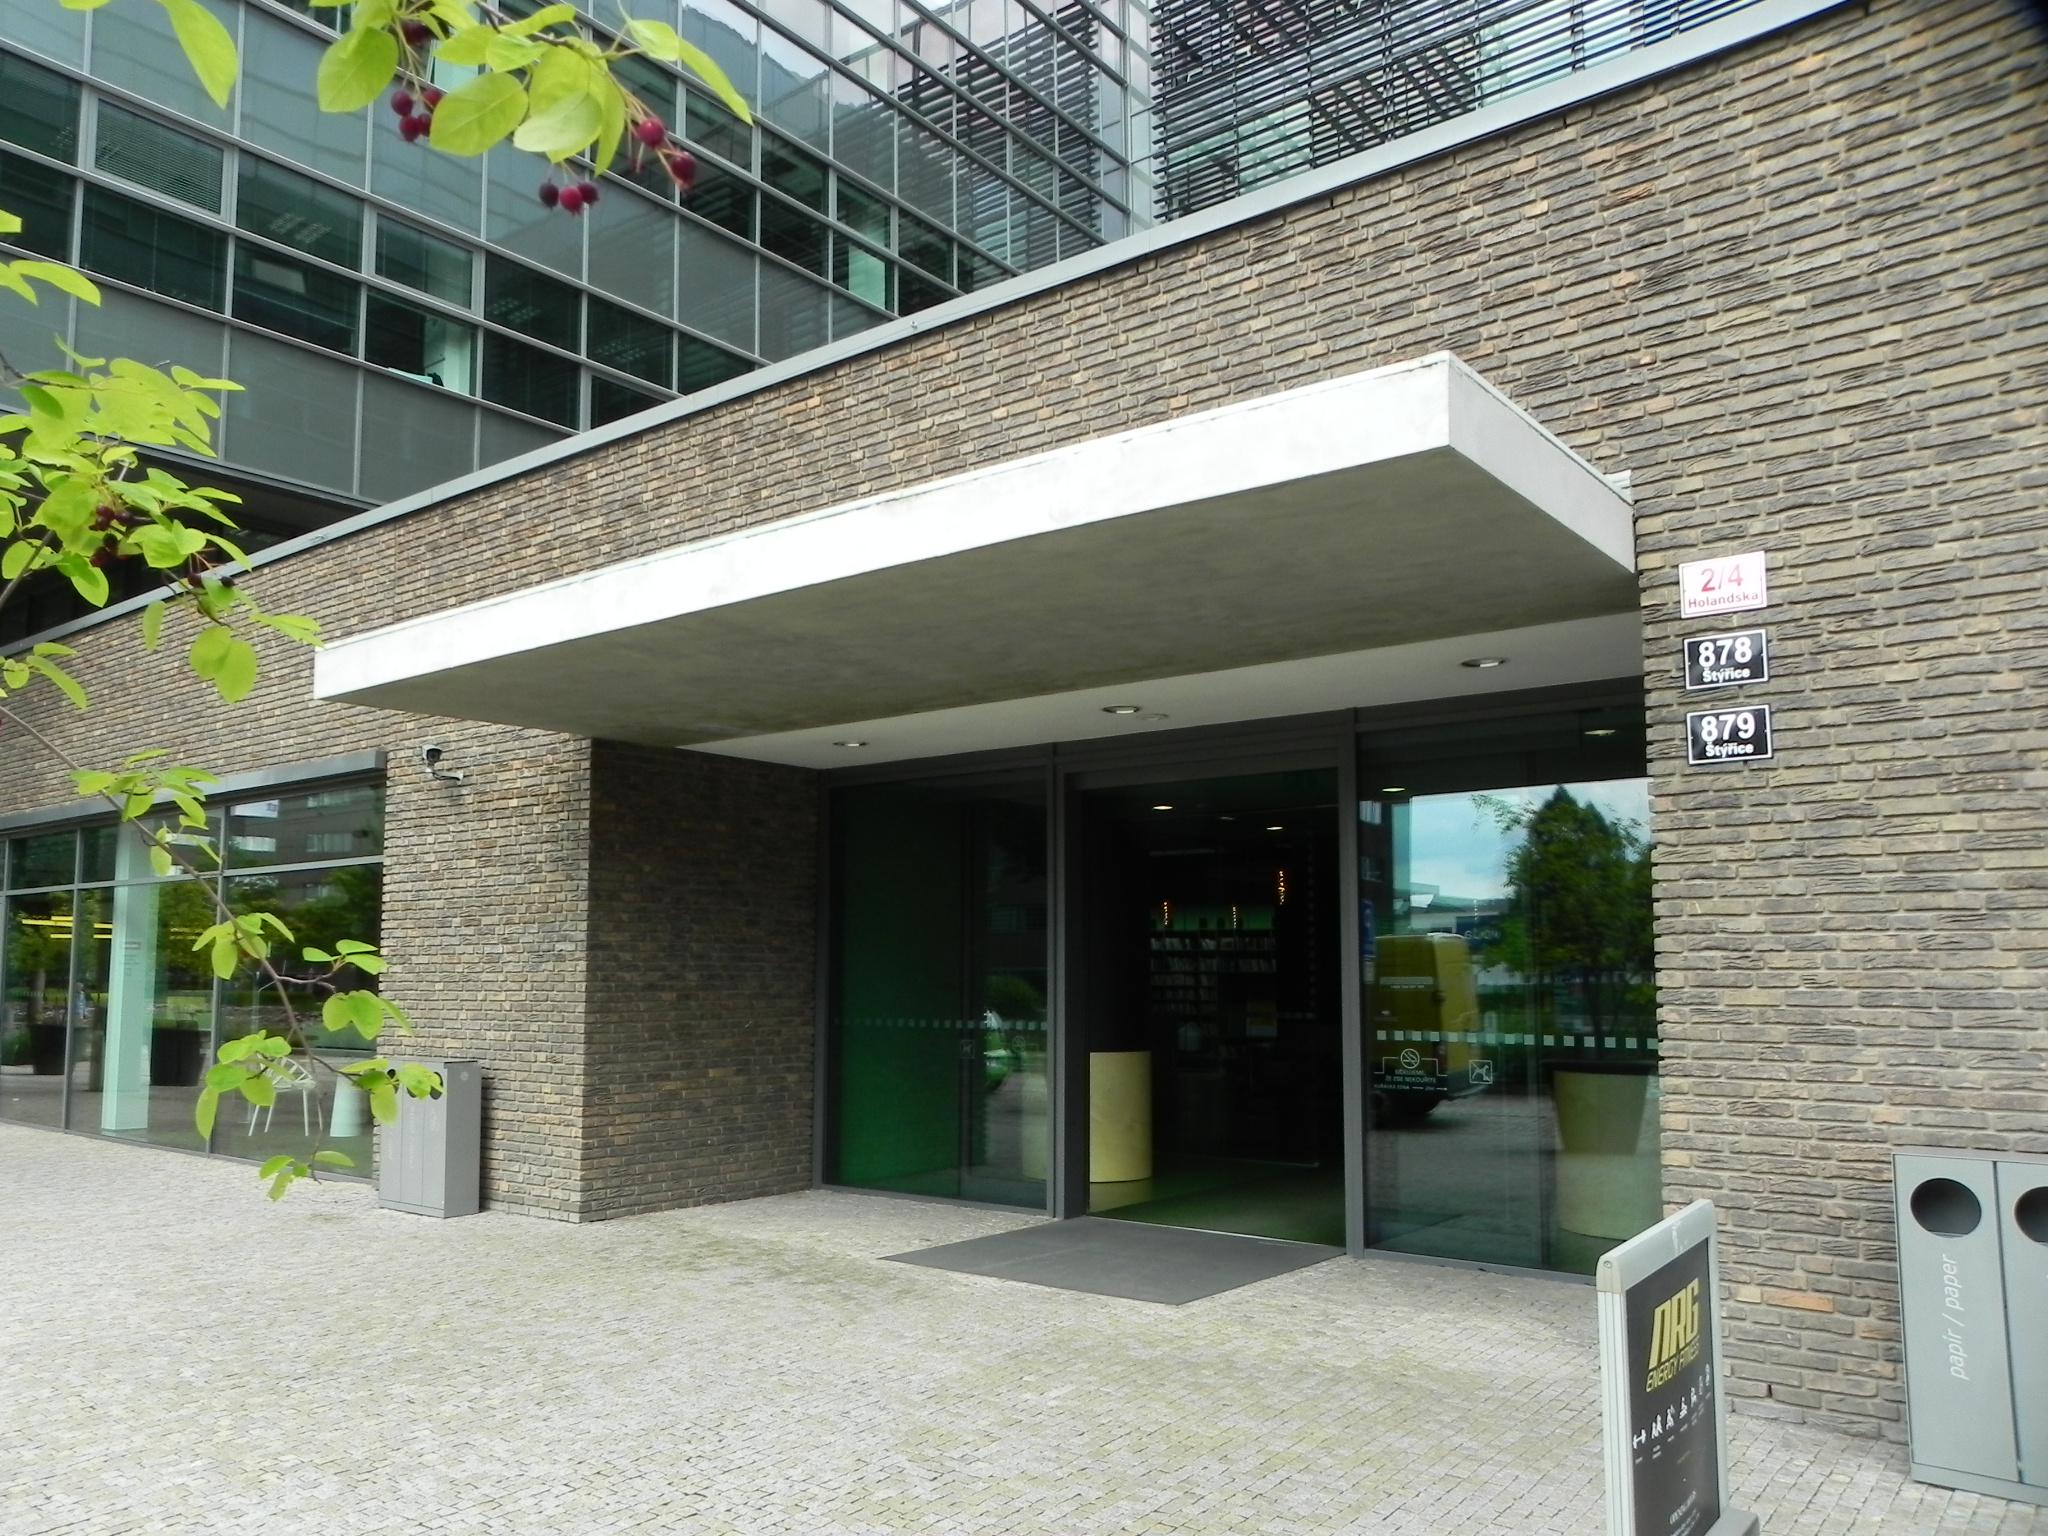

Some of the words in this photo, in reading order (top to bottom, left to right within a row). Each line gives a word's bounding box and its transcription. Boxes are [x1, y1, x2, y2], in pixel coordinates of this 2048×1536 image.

[1700, 563, 1744, 593] 2/4
[1698, 636, 1753, 668] 878
[1701, 712, 1756, 742] 879
[1942, 1253, 1965, 1311] paper
[1646, 1357, 1678, 1393] ENERGY
